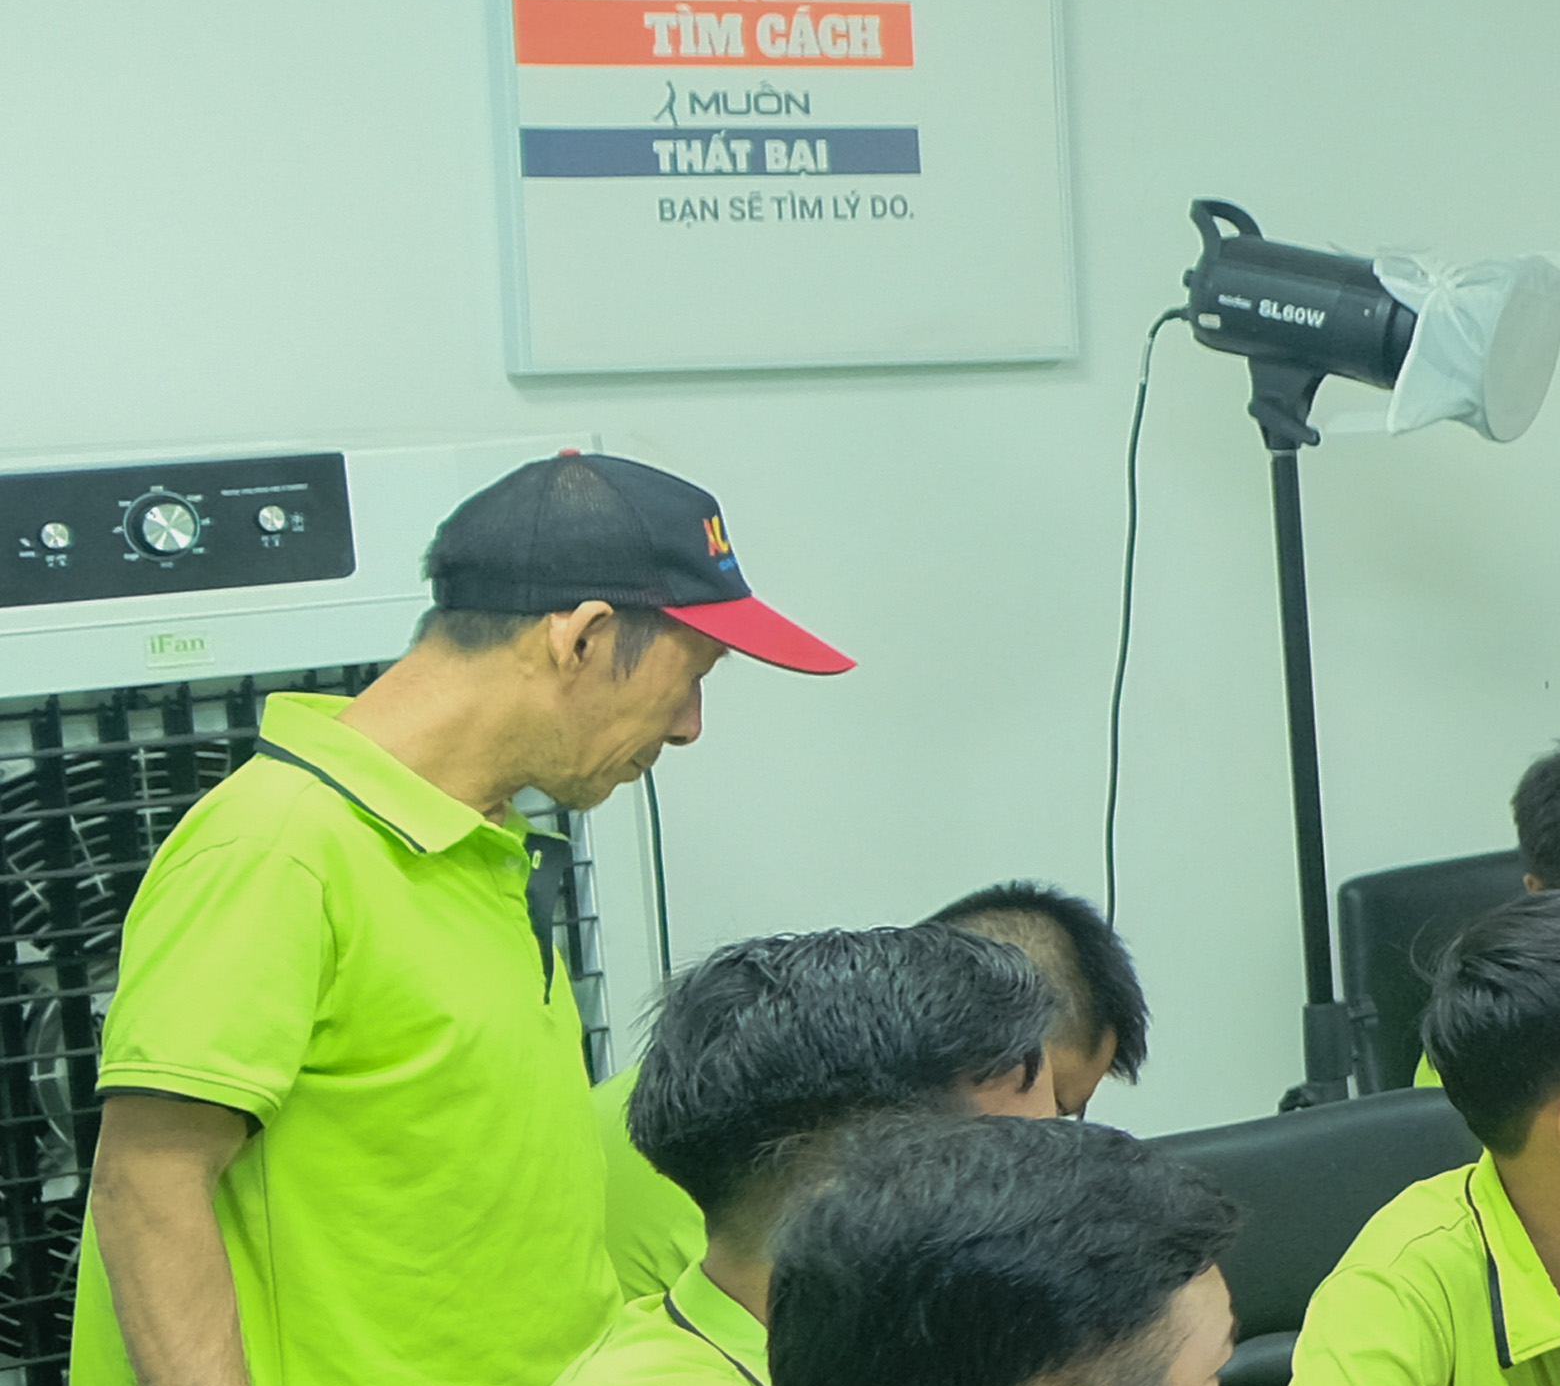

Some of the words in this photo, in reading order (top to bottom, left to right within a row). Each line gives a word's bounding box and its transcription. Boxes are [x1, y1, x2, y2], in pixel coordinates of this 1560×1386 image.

[643, 3, 746, 57] TÌM
[755, 4, 883, 59] CÁCH
[653, 129, 752, 175] THẤT
[765, 138, 830, 178] BẠI
[658, 196, 719, 229] BẠN
[729, 190, 766, 223] SẼ
[771, 190, 824, 222] TÌM
[832, 190, 861, 222] LÝ
[870, 194, 915, 222] DO.
[149, 633, 206, 655] iFan
